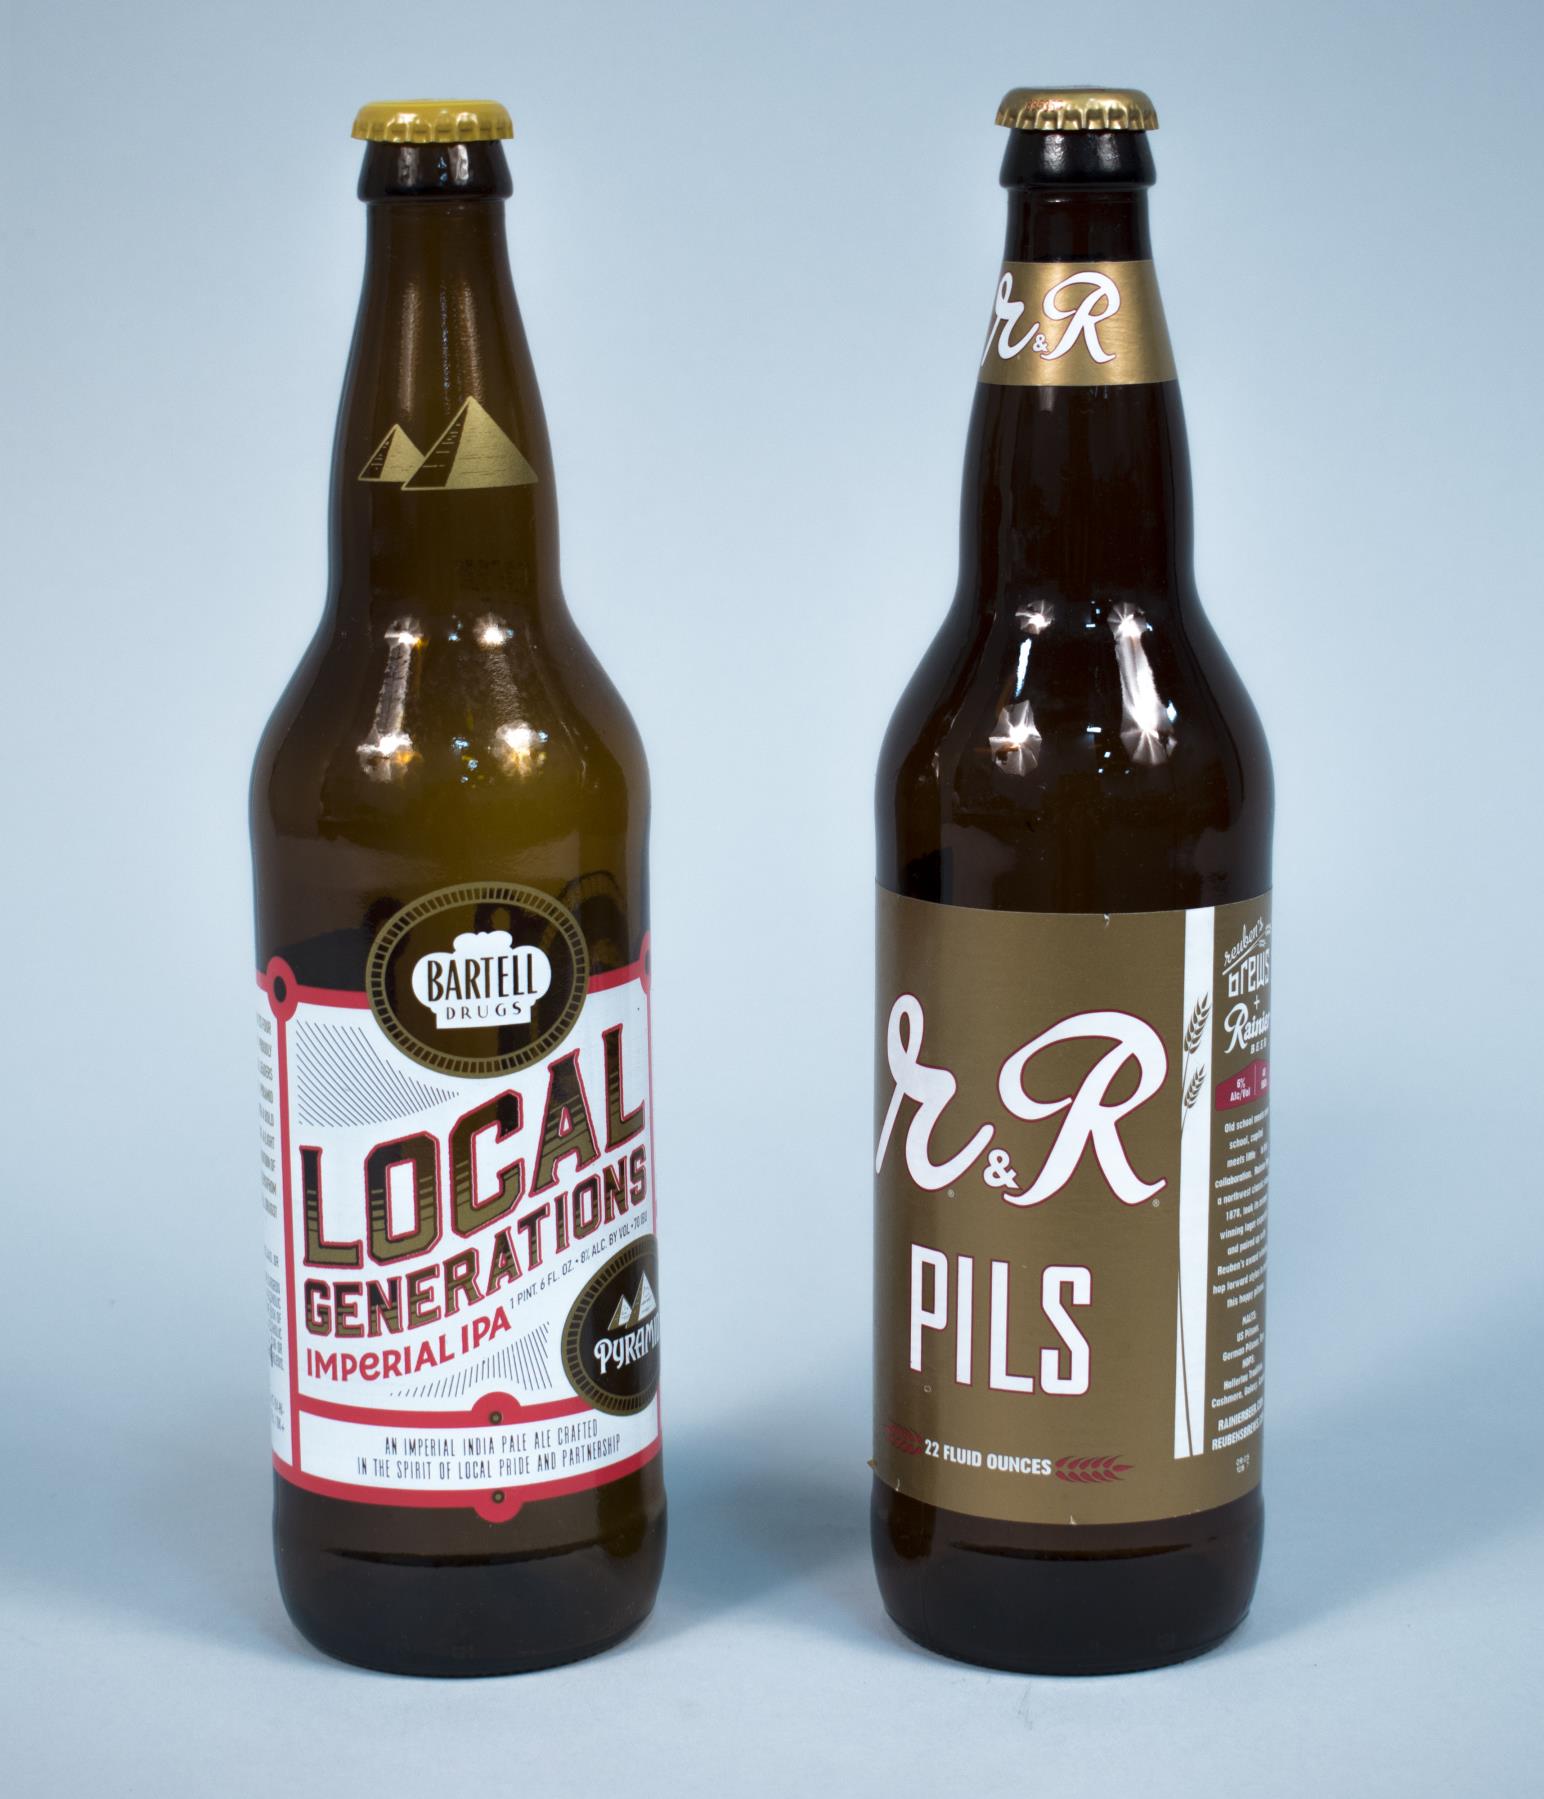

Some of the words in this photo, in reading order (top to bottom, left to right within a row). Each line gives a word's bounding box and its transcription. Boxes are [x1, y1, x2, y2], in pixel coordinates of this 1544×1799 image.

[1040, 271, 1121, 363] R
[427, 953, 537, 1002] BARTELL
[445, 1001, 523, 1021] DRUGS
[997, 1008, 1169, 1208] R
[299, 1023, 646, 1269] LOCAL
[982, 1147, 1020, 1190] &
[304, 1144, 647, 1338] GENERATIONS
[517, 1285, 538, 1305] PINT.
[540, 1278, 546, 1290] 6
[547, 1270, 560, 1287] FL.
[562, 1261, 574, 1276] OZ.
[580, 1250, 590, 1264] 8%
[591, 1240, 607, 1259] ALC.
[609, 1232, 619, 1246] BY
[619, 1223, 631, 1239] VOL
[461, 1305, 512, 1355] IPA
[909, 1242, 1093, 1396] PILS
[357, 1456, 368, 1476] IN
[373, 1458, 390, 1478] THE
[396, 1460, 432, 1480] SPIRIT
[439, 1461, 452, 1480] OF
[458, 1459, 492, 1480] LOCAL
[499, 1455, 531, 1477] PRIDE
[537, 1451, 556, 1473] AND
[562, 1433, 621, 1468] PARTNERSHIP
[385, 1436, 398, 1456] AN
[404, 1437, 456, 1457] IMPERIAL
[463, 1436, 495, 1456] INDIA
[502, 1433, 527, 1453] PALE
[534, 1428, 551, 1450] ALE
[557, 1418, 598, 1446] CRAFTED
[924, 1439, 940, 1459] 22
[943, 1444, 982, 1468] FLUID
[986, 1453, 1052, 1476] OUNCES
